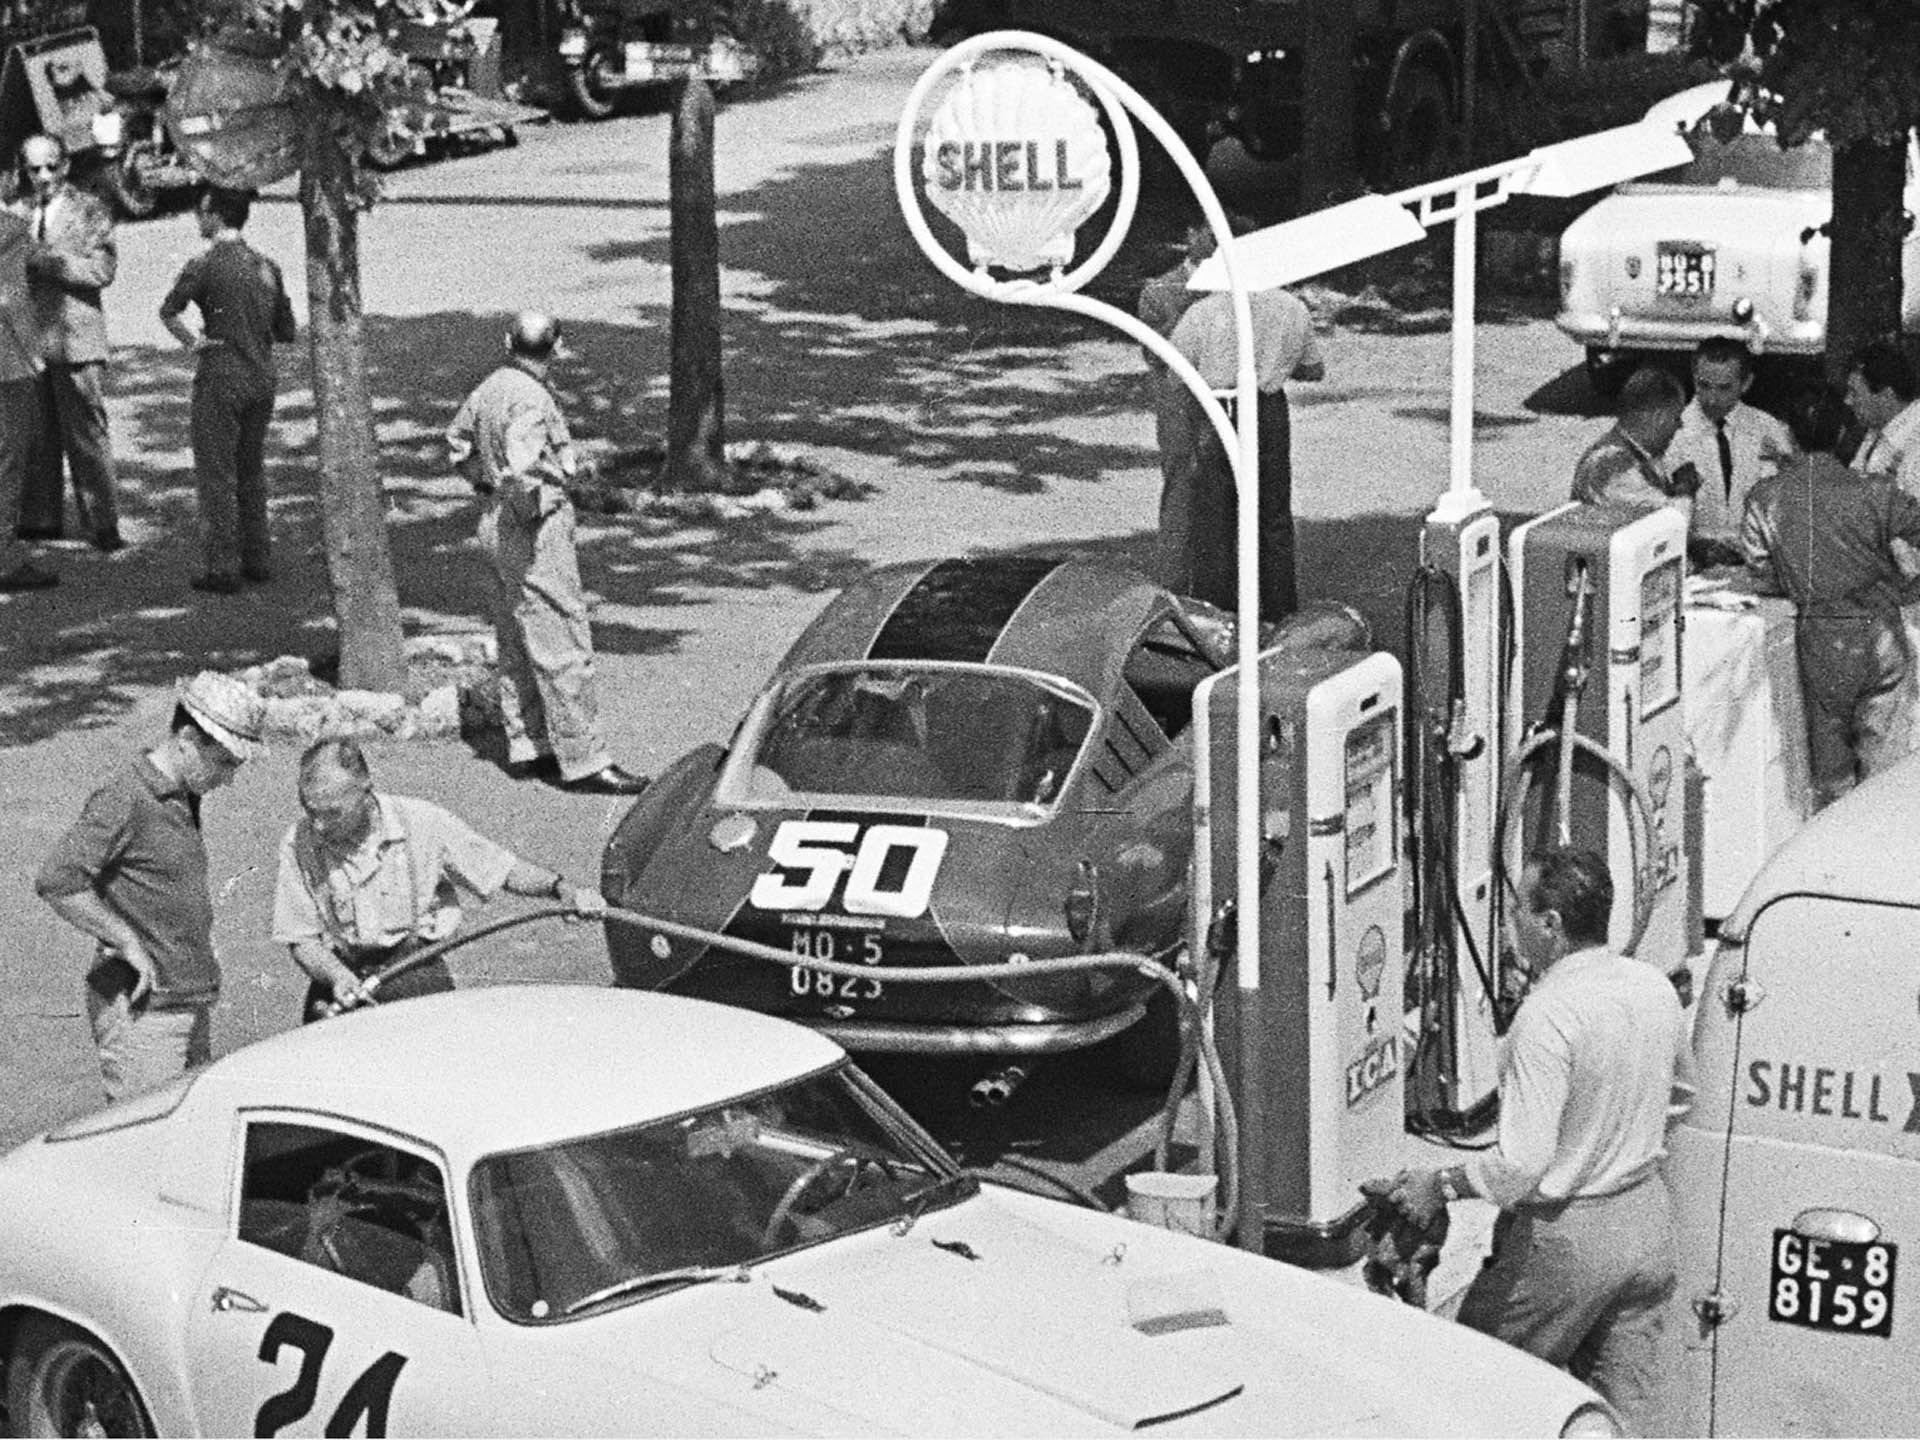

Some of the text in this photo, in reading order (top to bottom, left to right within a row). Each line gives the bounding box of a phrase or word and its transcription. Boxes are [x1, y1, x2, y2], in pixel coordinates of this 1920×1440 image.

[937, 138, 1083, 192] SHELL
[750, 820, 949, 919] 50
[1747, 1060, 1889, 1122] SHELL
[1775, 1277, 1888, 1329] 8159
[254, 1311, 409, 1439] 24
